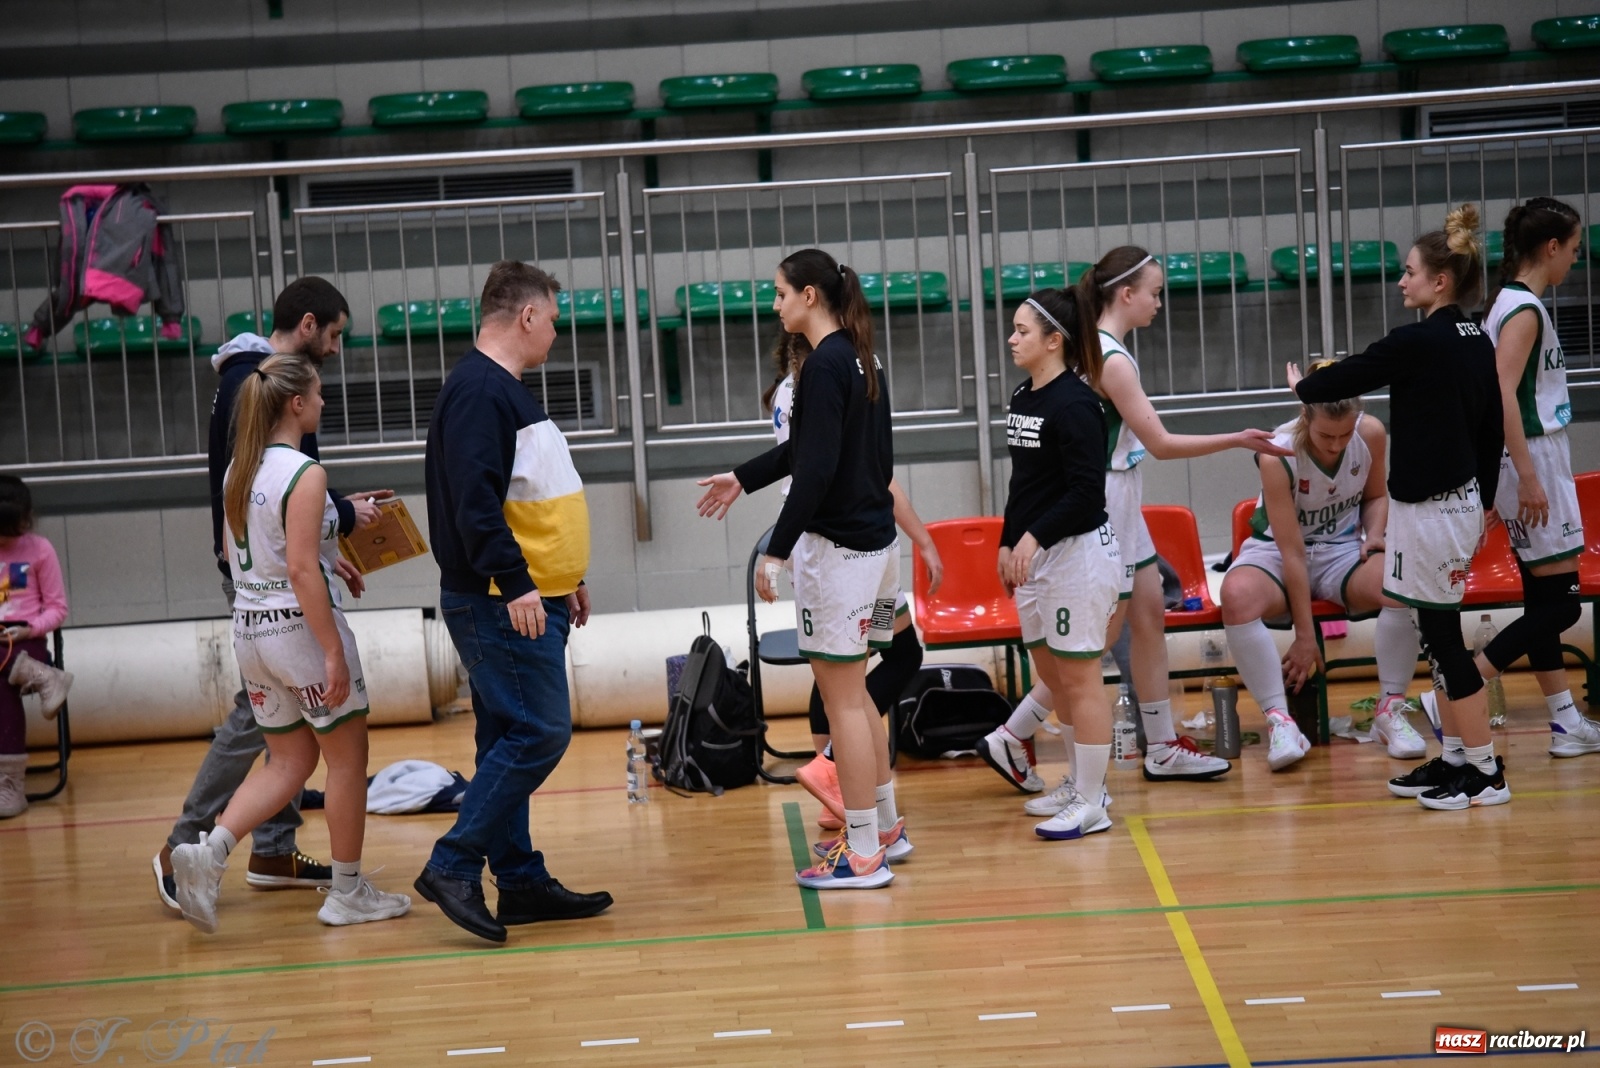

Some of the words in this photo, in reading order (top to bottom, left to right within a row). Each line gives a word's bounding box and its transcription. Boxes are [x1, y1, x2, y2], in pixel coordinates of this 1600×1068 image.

[1021, 438, 1041, 448] TEAM
[802, 608, 814, 637] 6
[1056, 607, 1070, 636] 8
